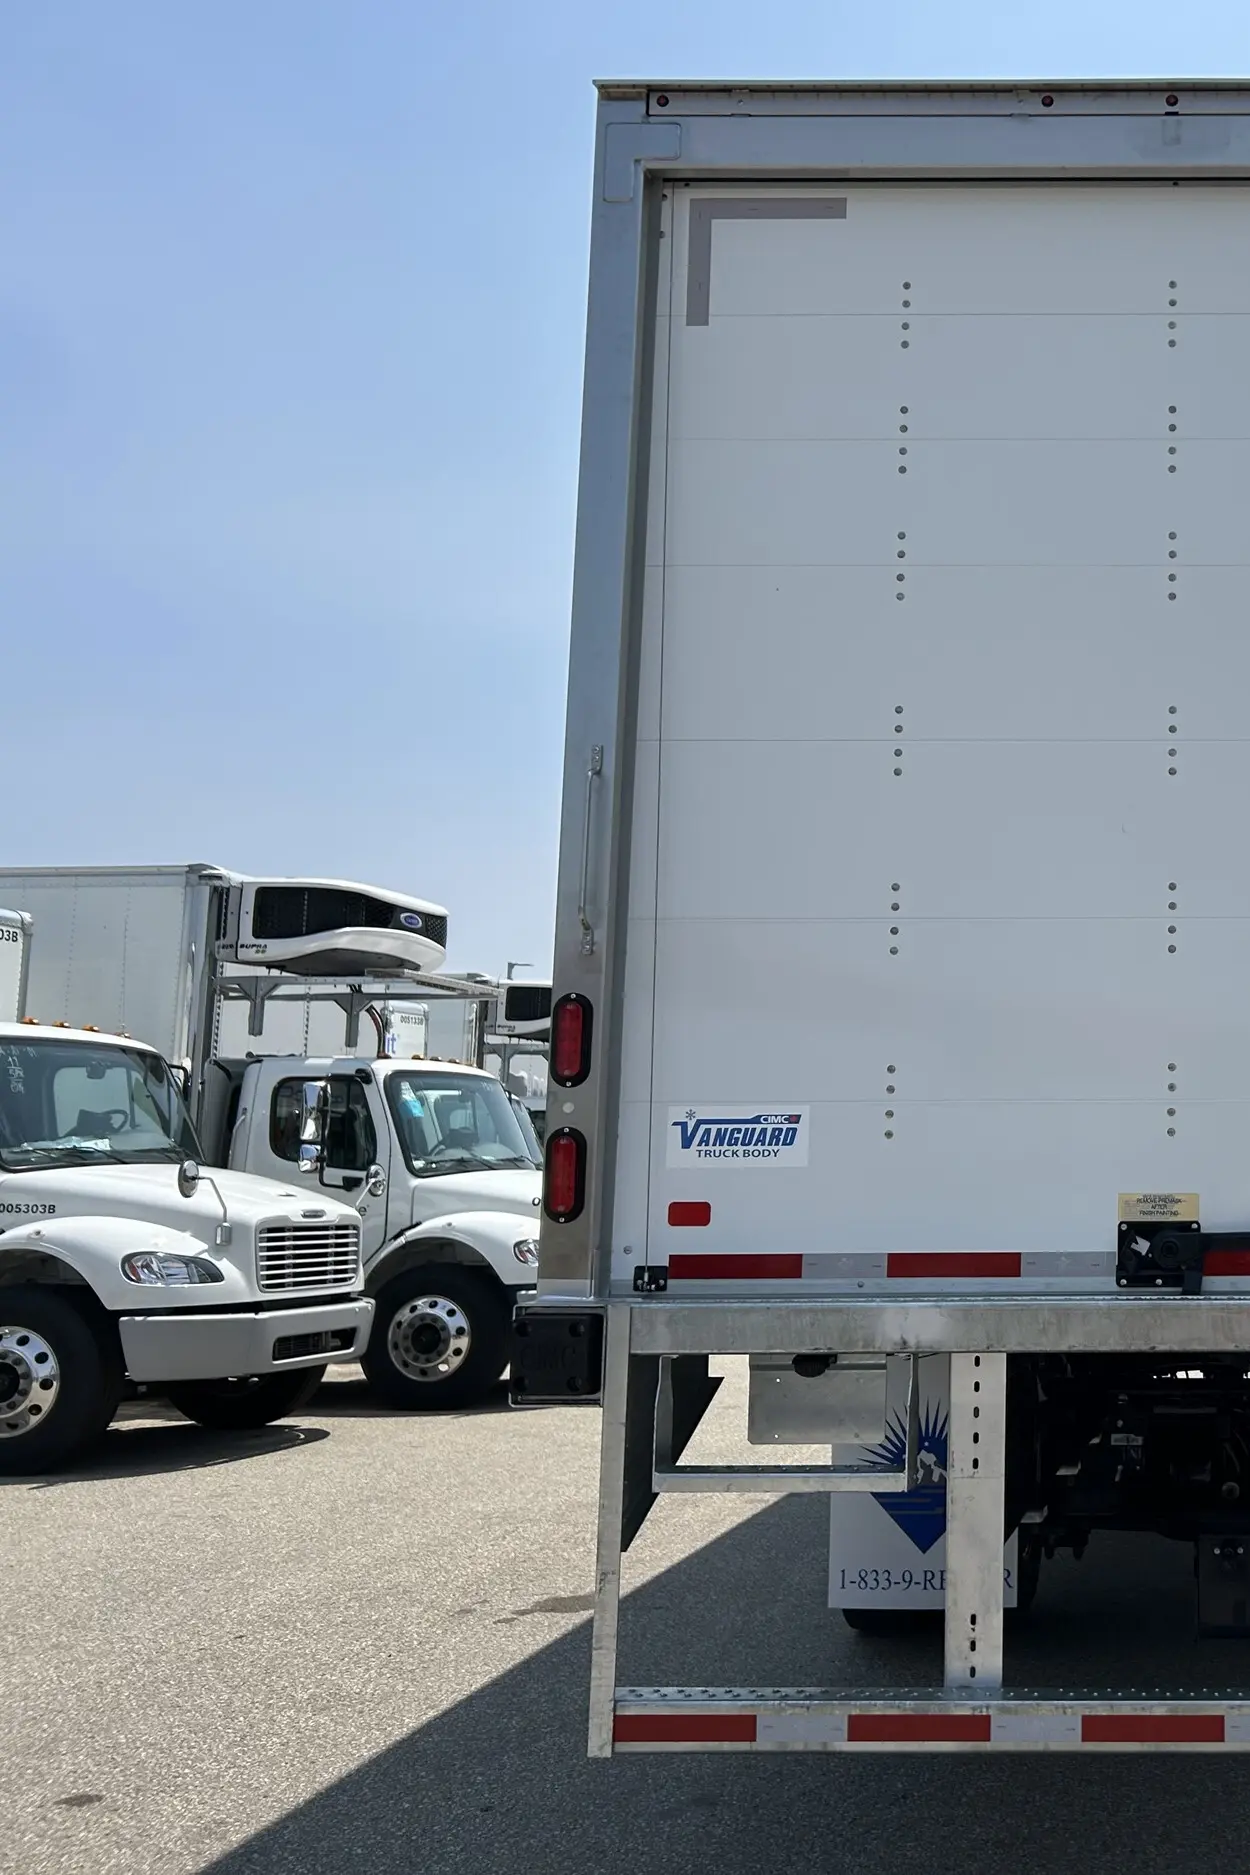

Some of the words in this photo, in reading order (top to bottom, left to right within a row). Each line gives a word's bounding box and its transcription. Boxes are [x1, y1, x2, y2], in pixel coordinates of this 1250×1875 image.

[760, 1115, 789, 1124] CIMC
[671, 1118, 799, 1149] VANGUARD
[696, 1149, 739, 1158] TRUCK
[742, 1149, 780, 1158] BODY
